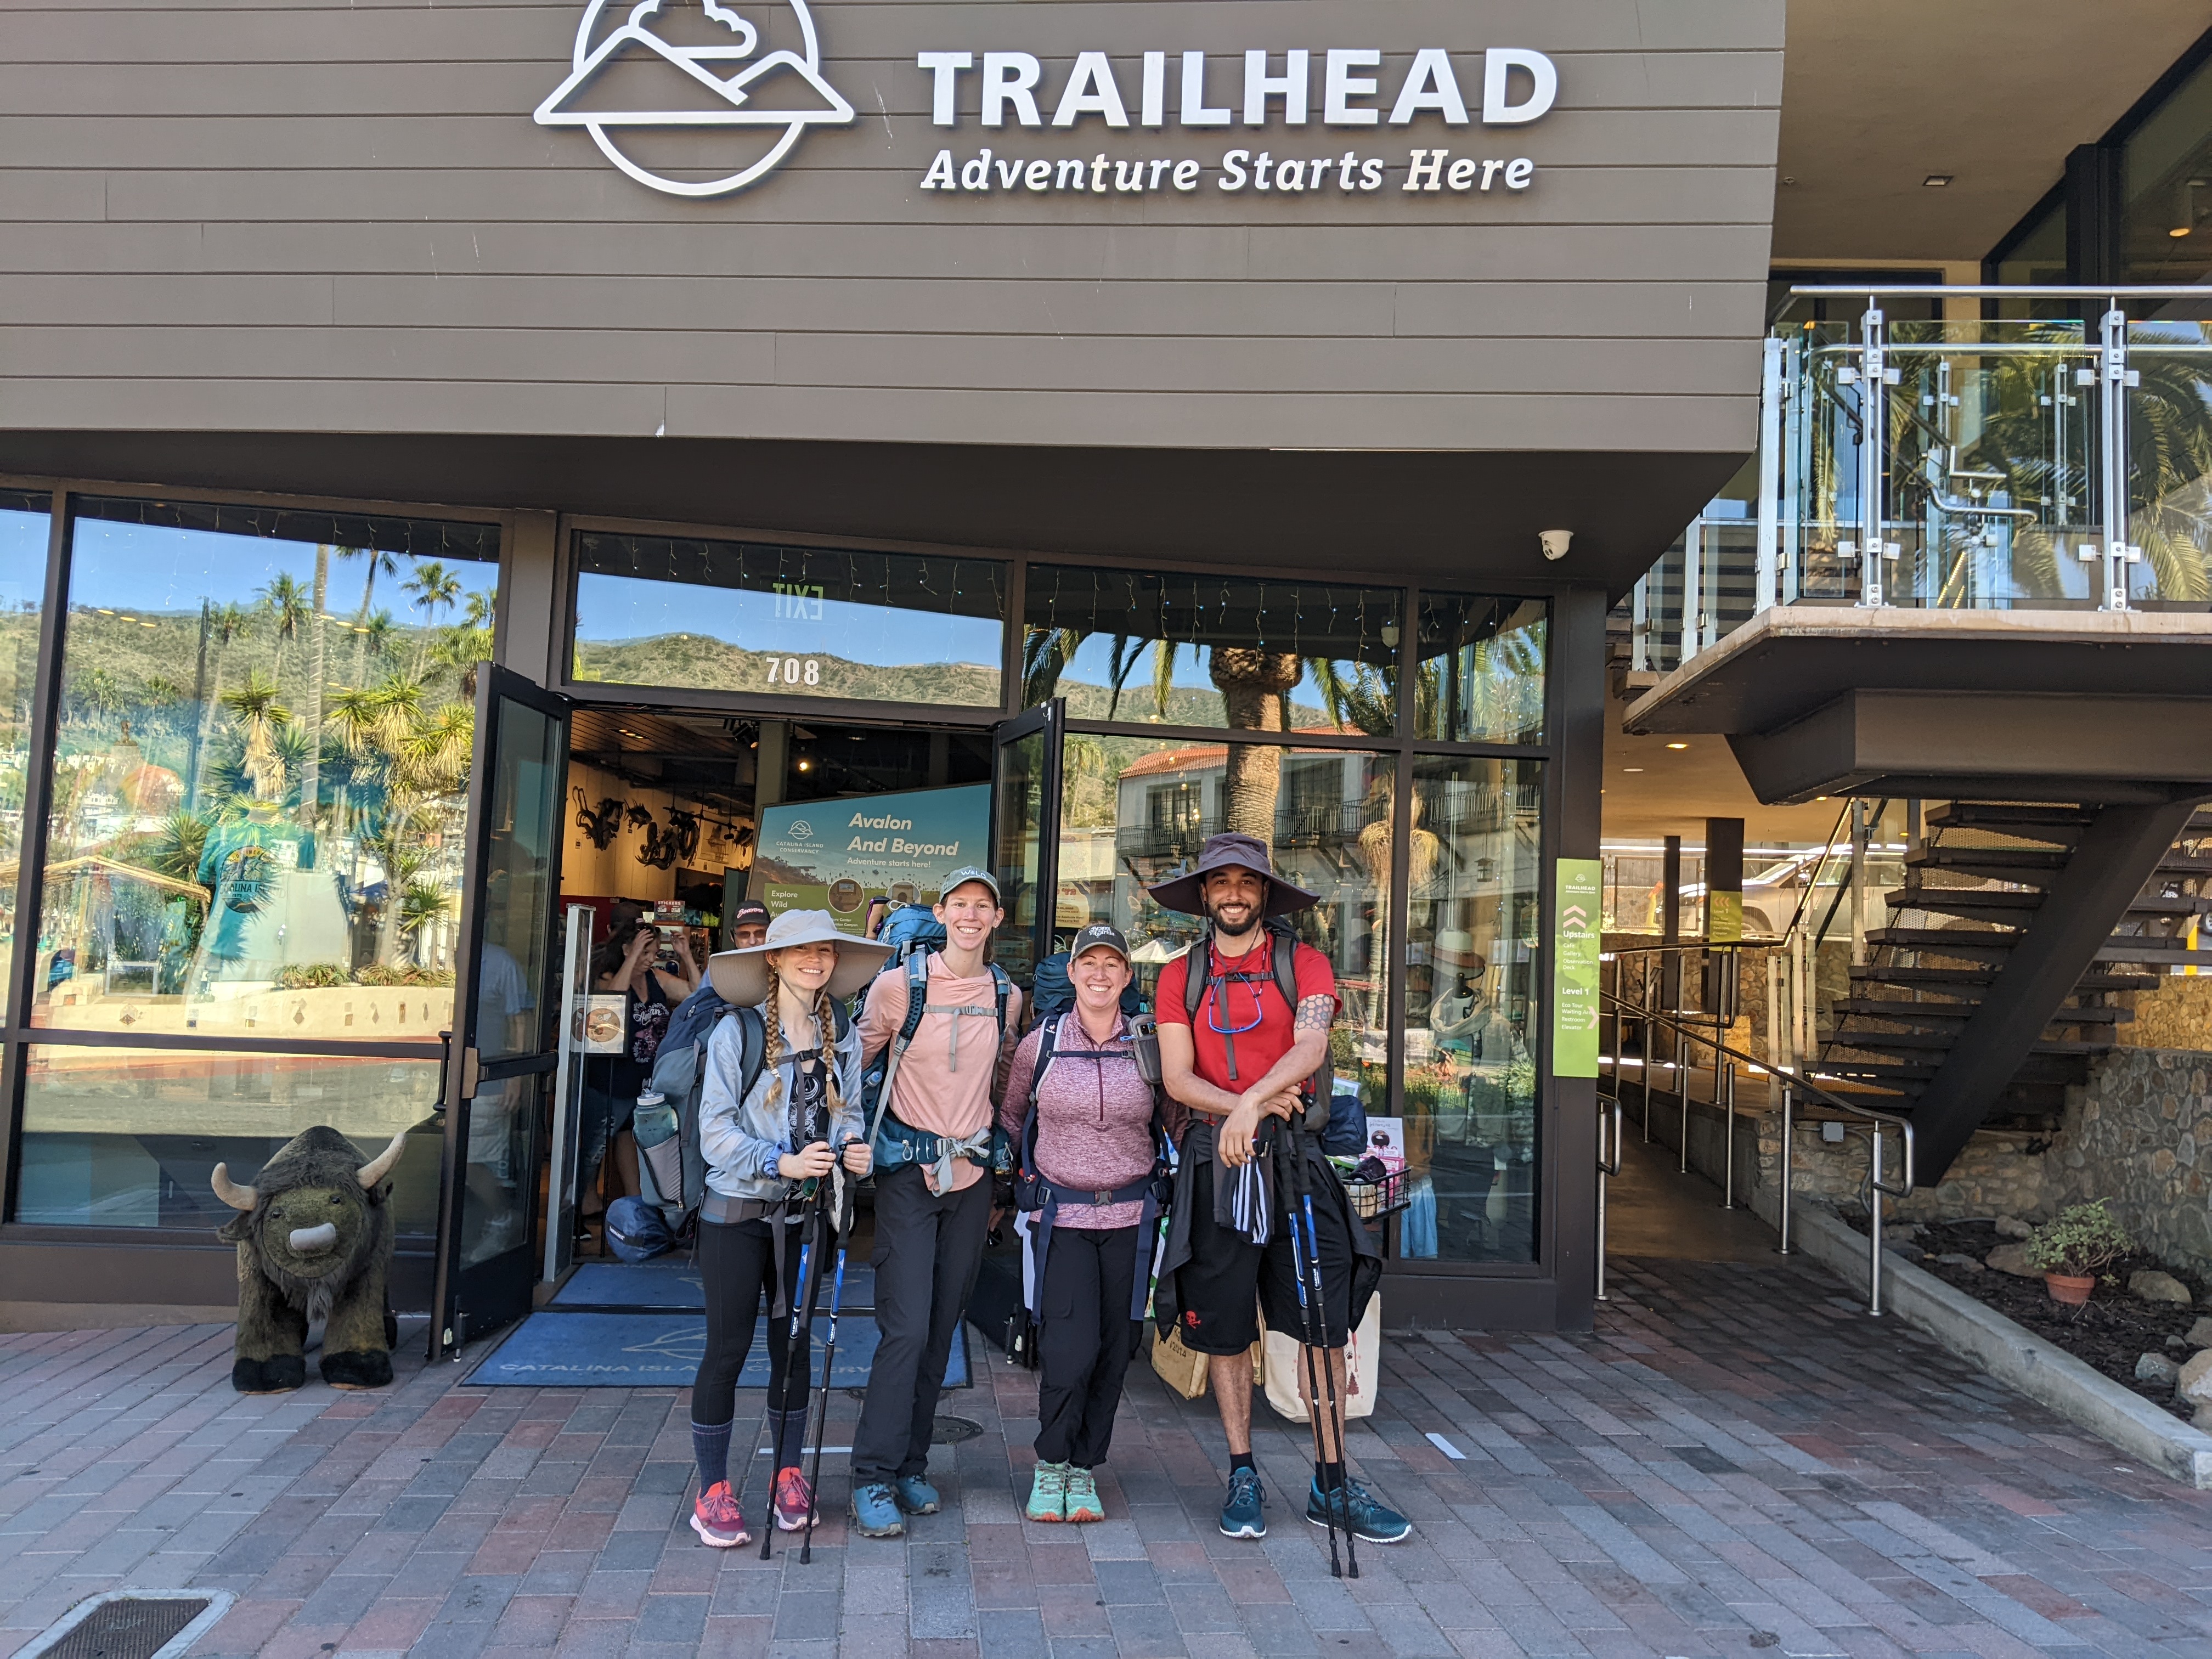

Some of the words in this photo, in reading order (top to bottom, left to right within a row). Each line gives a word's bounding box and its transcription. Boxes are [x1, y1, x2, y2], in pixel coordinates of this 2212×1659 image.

[917, 48, 1557, 128] TRAILHEAD
[919, 148, 1200, 192] Adventure
[1217, 149, 1384, 192] Starts
[1402, 149, 1534, 192] Here
[766, 657, 819, 685] 708
[848, 812, 912, 830] Avalon
[847, 836, 888, 853] And
[891, 838, 959, 857] Beyond
[847, 857, 887, 866] Adventure
[771, 890, 798, 900] Explore
[1563, 930, 1595, 939] Upstairs
[499, 1363, 630, 1372] CATALINA
